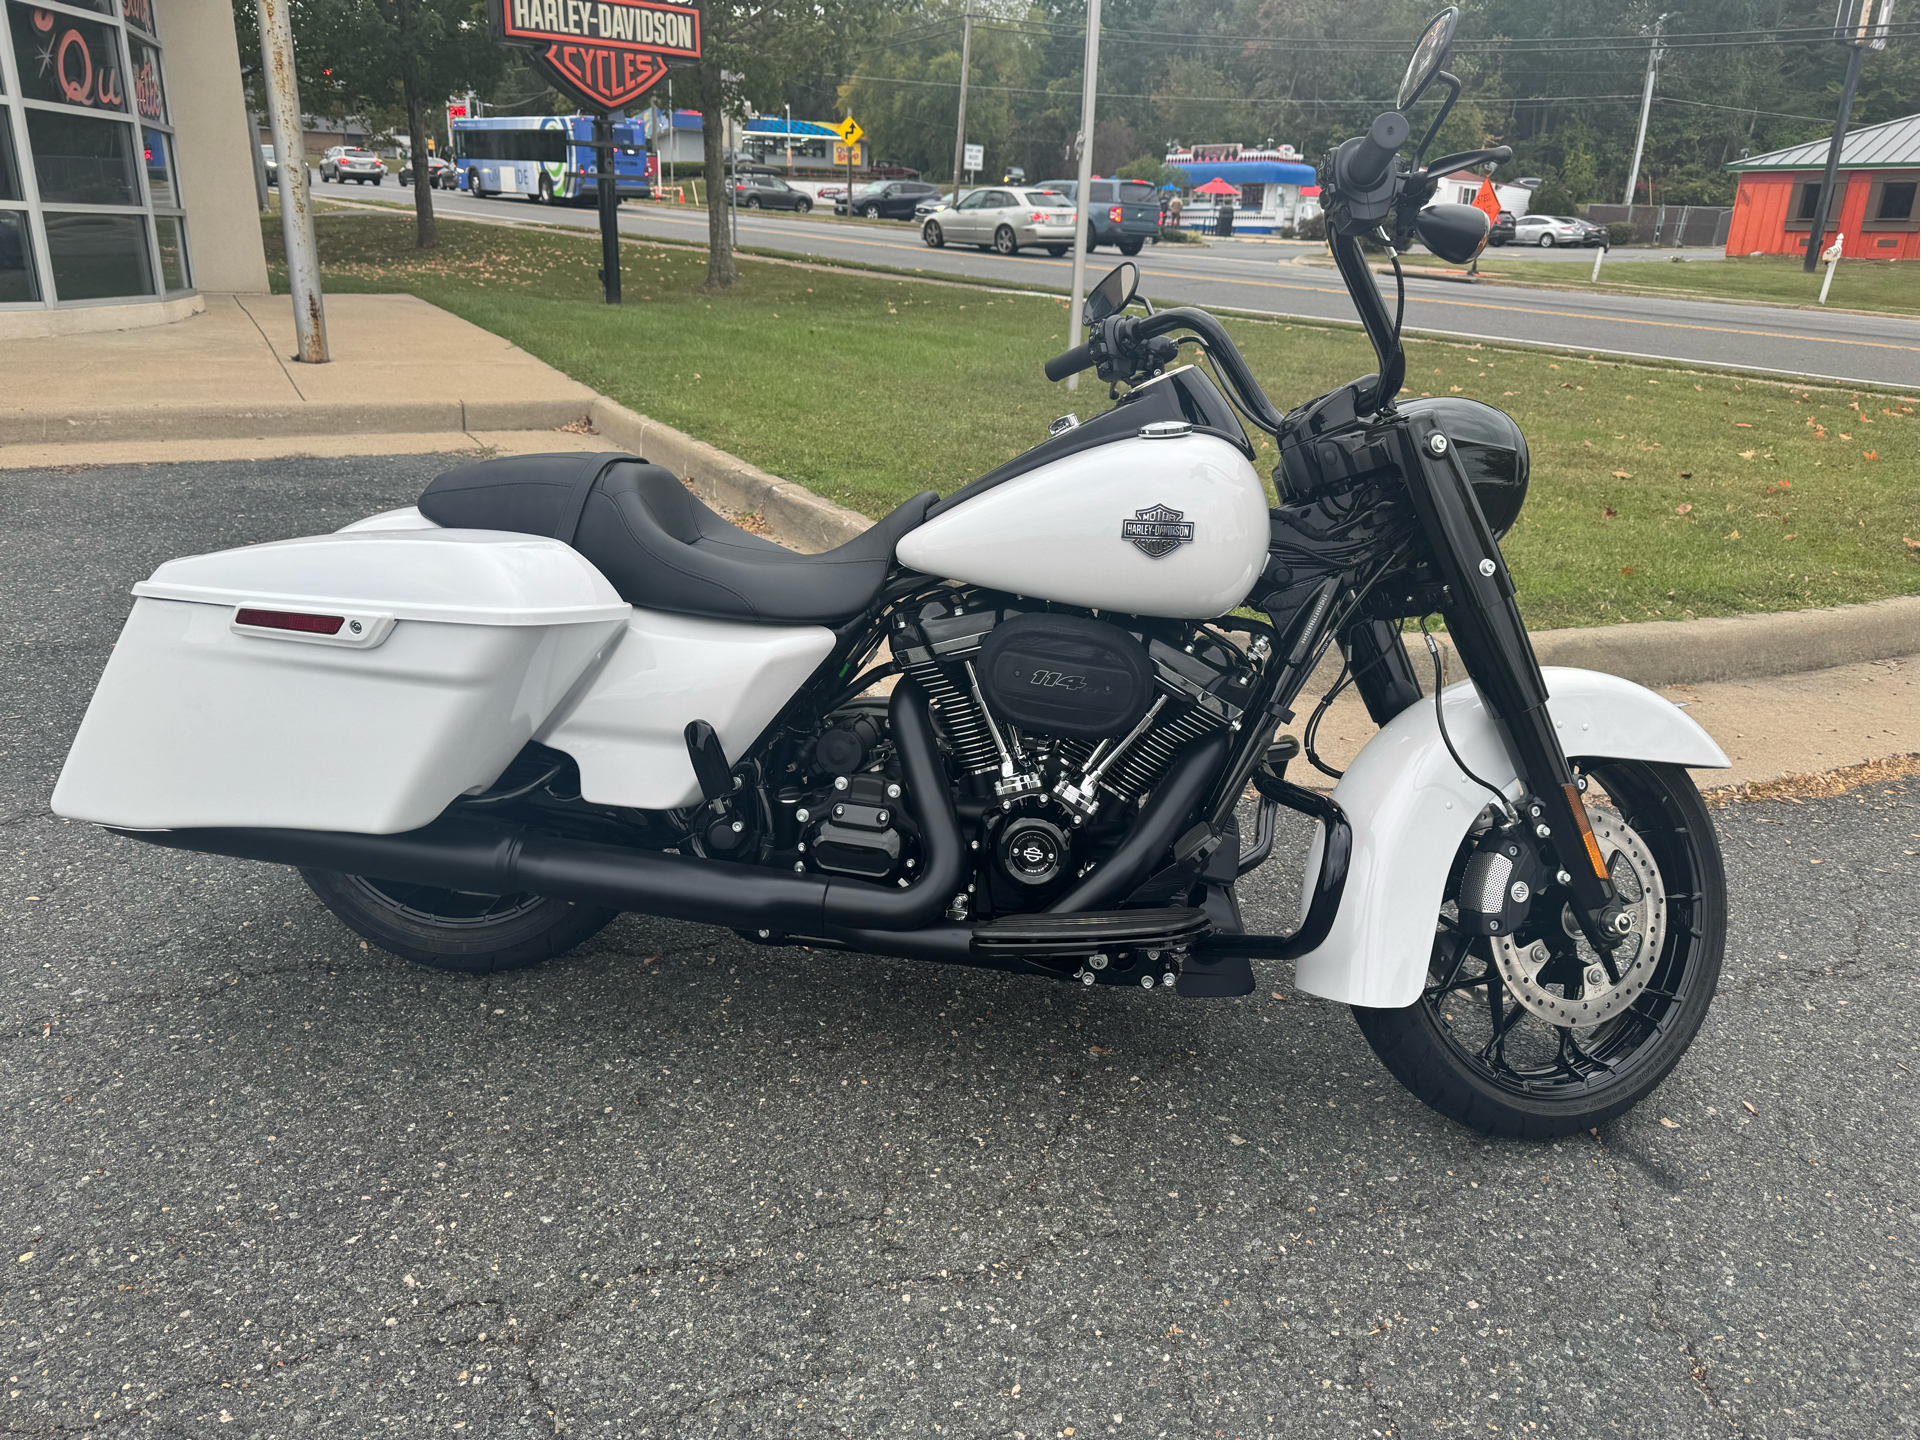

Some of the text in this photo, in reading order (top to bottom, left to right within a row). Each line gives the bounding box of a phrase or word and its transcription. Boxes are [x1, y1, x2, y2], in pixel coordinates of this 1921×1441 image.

[514, 0, 692, 48] HARLEY-DAVIDSON
[562, 46, 652, 97] CYCLES
[1127, 523, 1190, 537] HARLEY-DAVIDSON
[1030, 669, 1087, 691] 114
